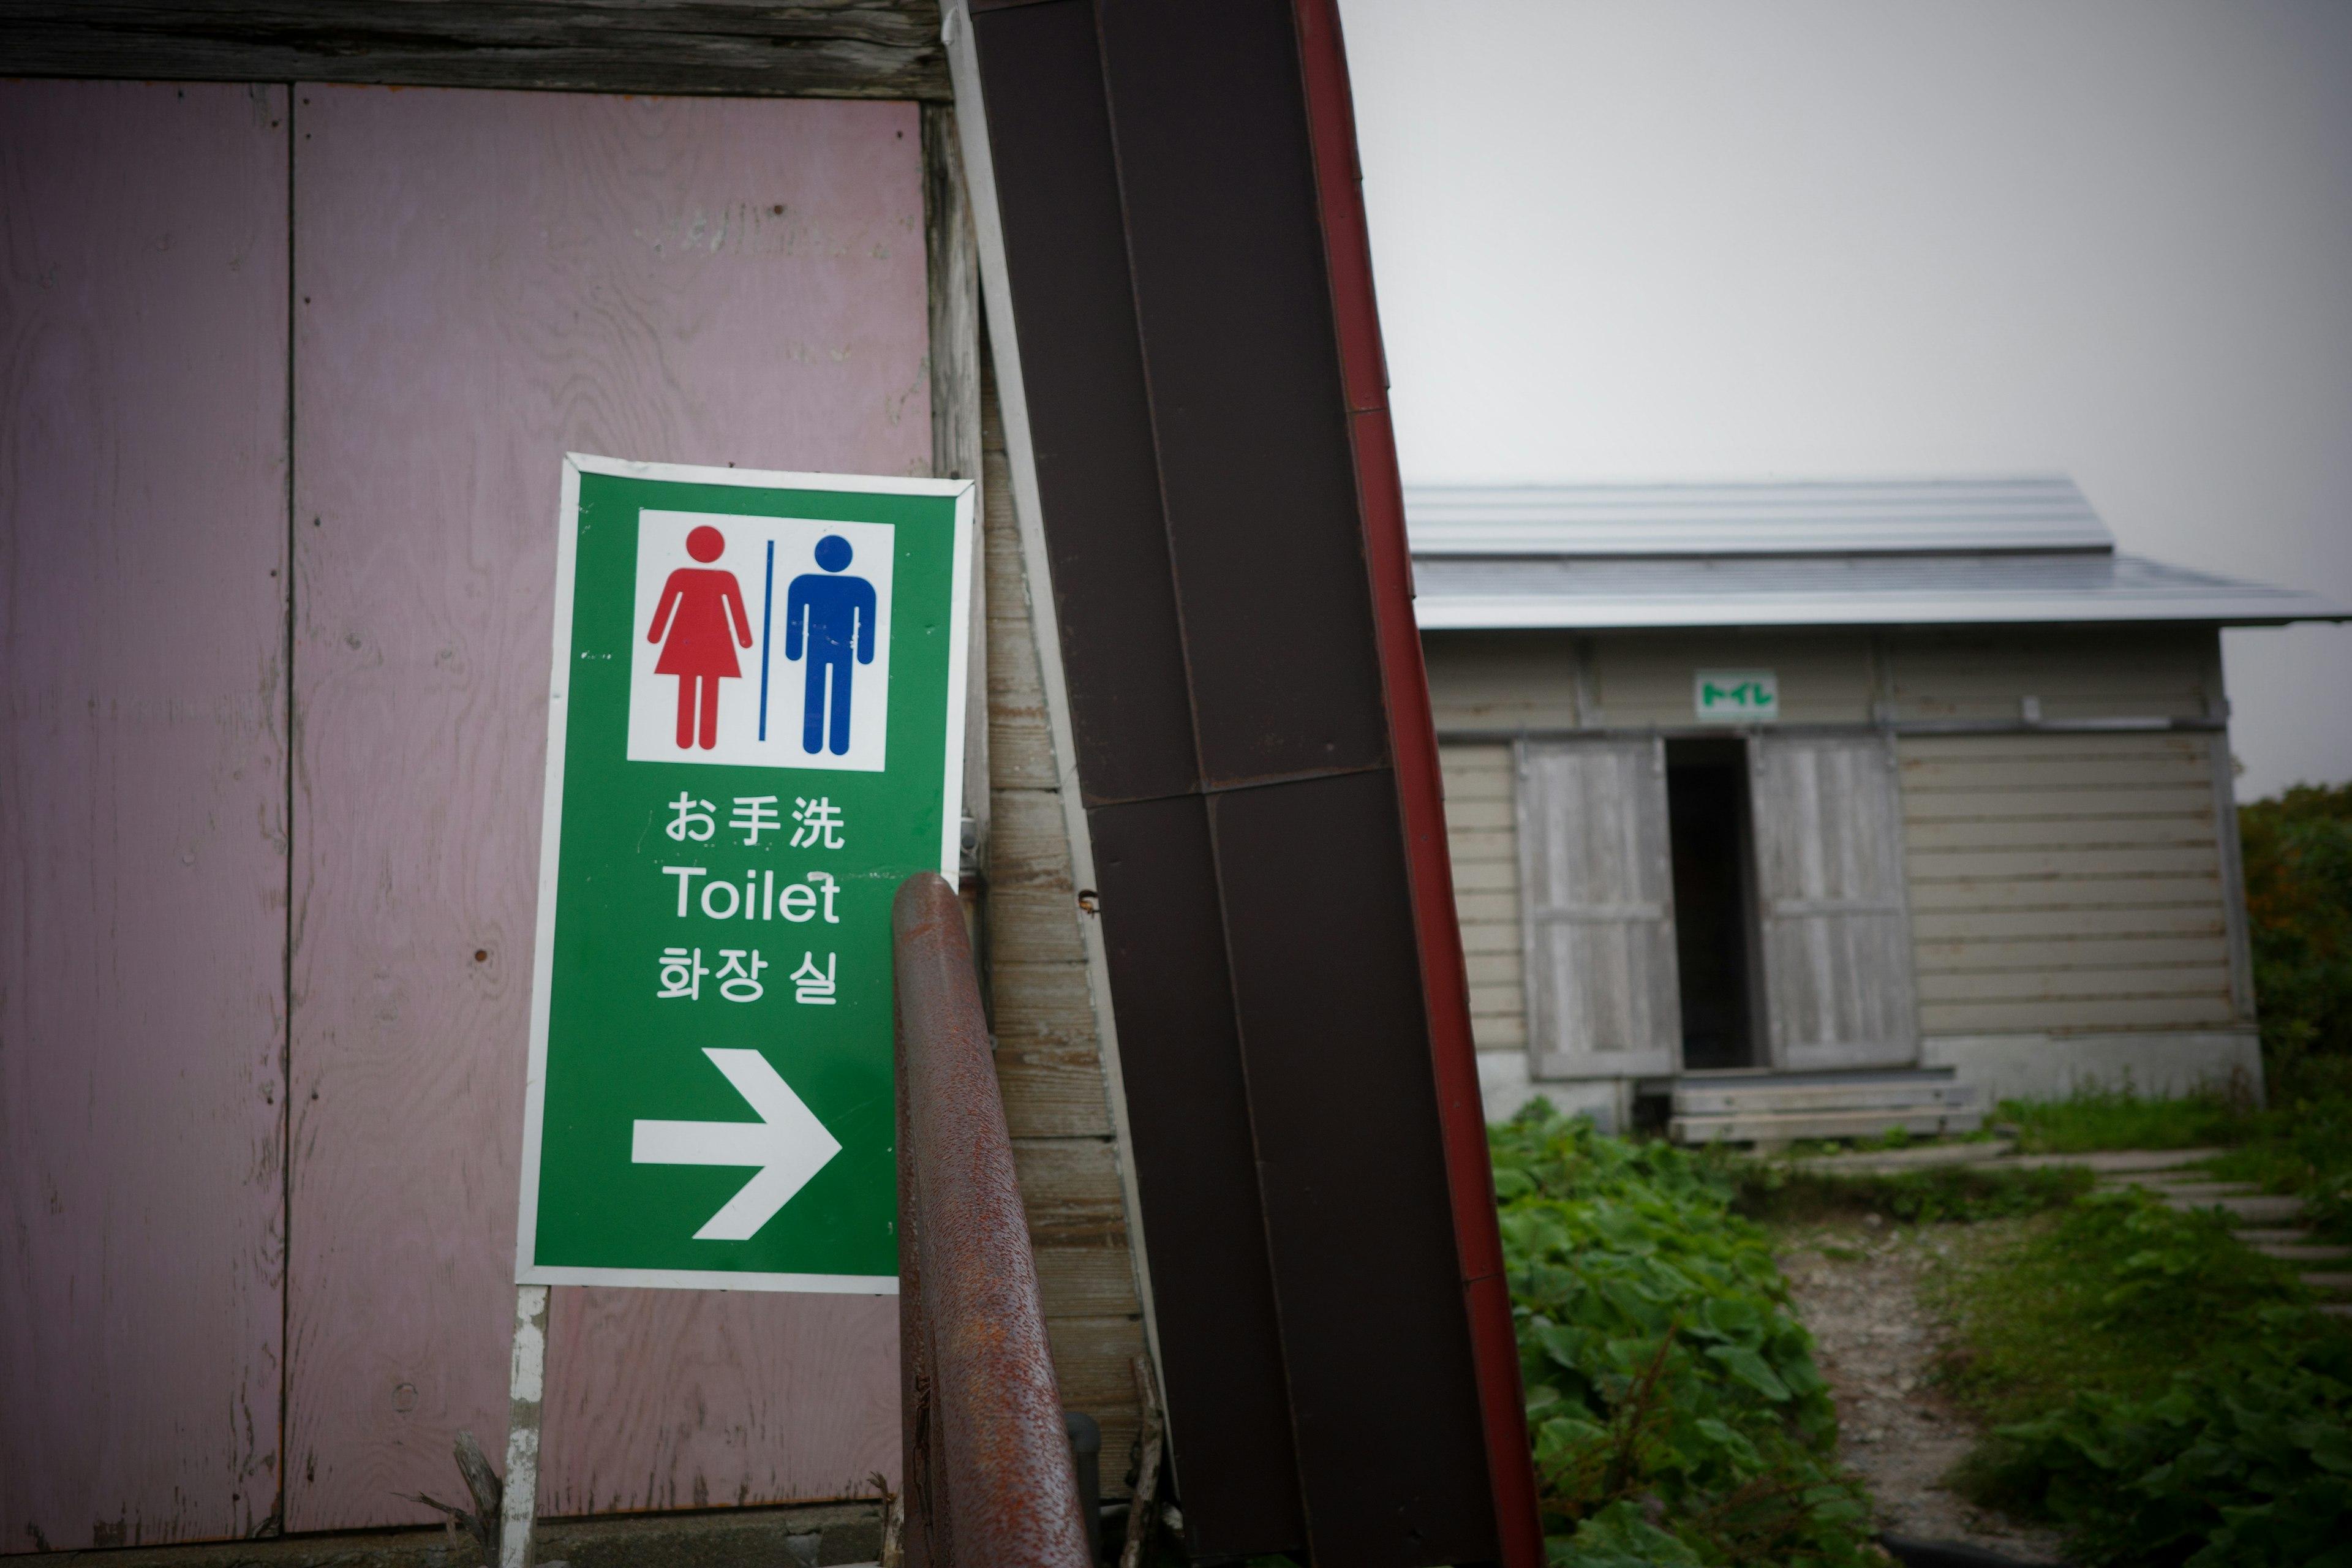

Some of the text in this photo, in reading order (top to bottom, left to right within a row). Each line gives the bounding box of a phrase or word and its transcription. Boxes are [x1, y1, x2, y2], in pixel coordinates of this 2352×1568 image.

[1703, 682, 1773, 707] トイレ
[666, 791, 845, 850] お手洗
[662, 865, 841, 924] Toilet
